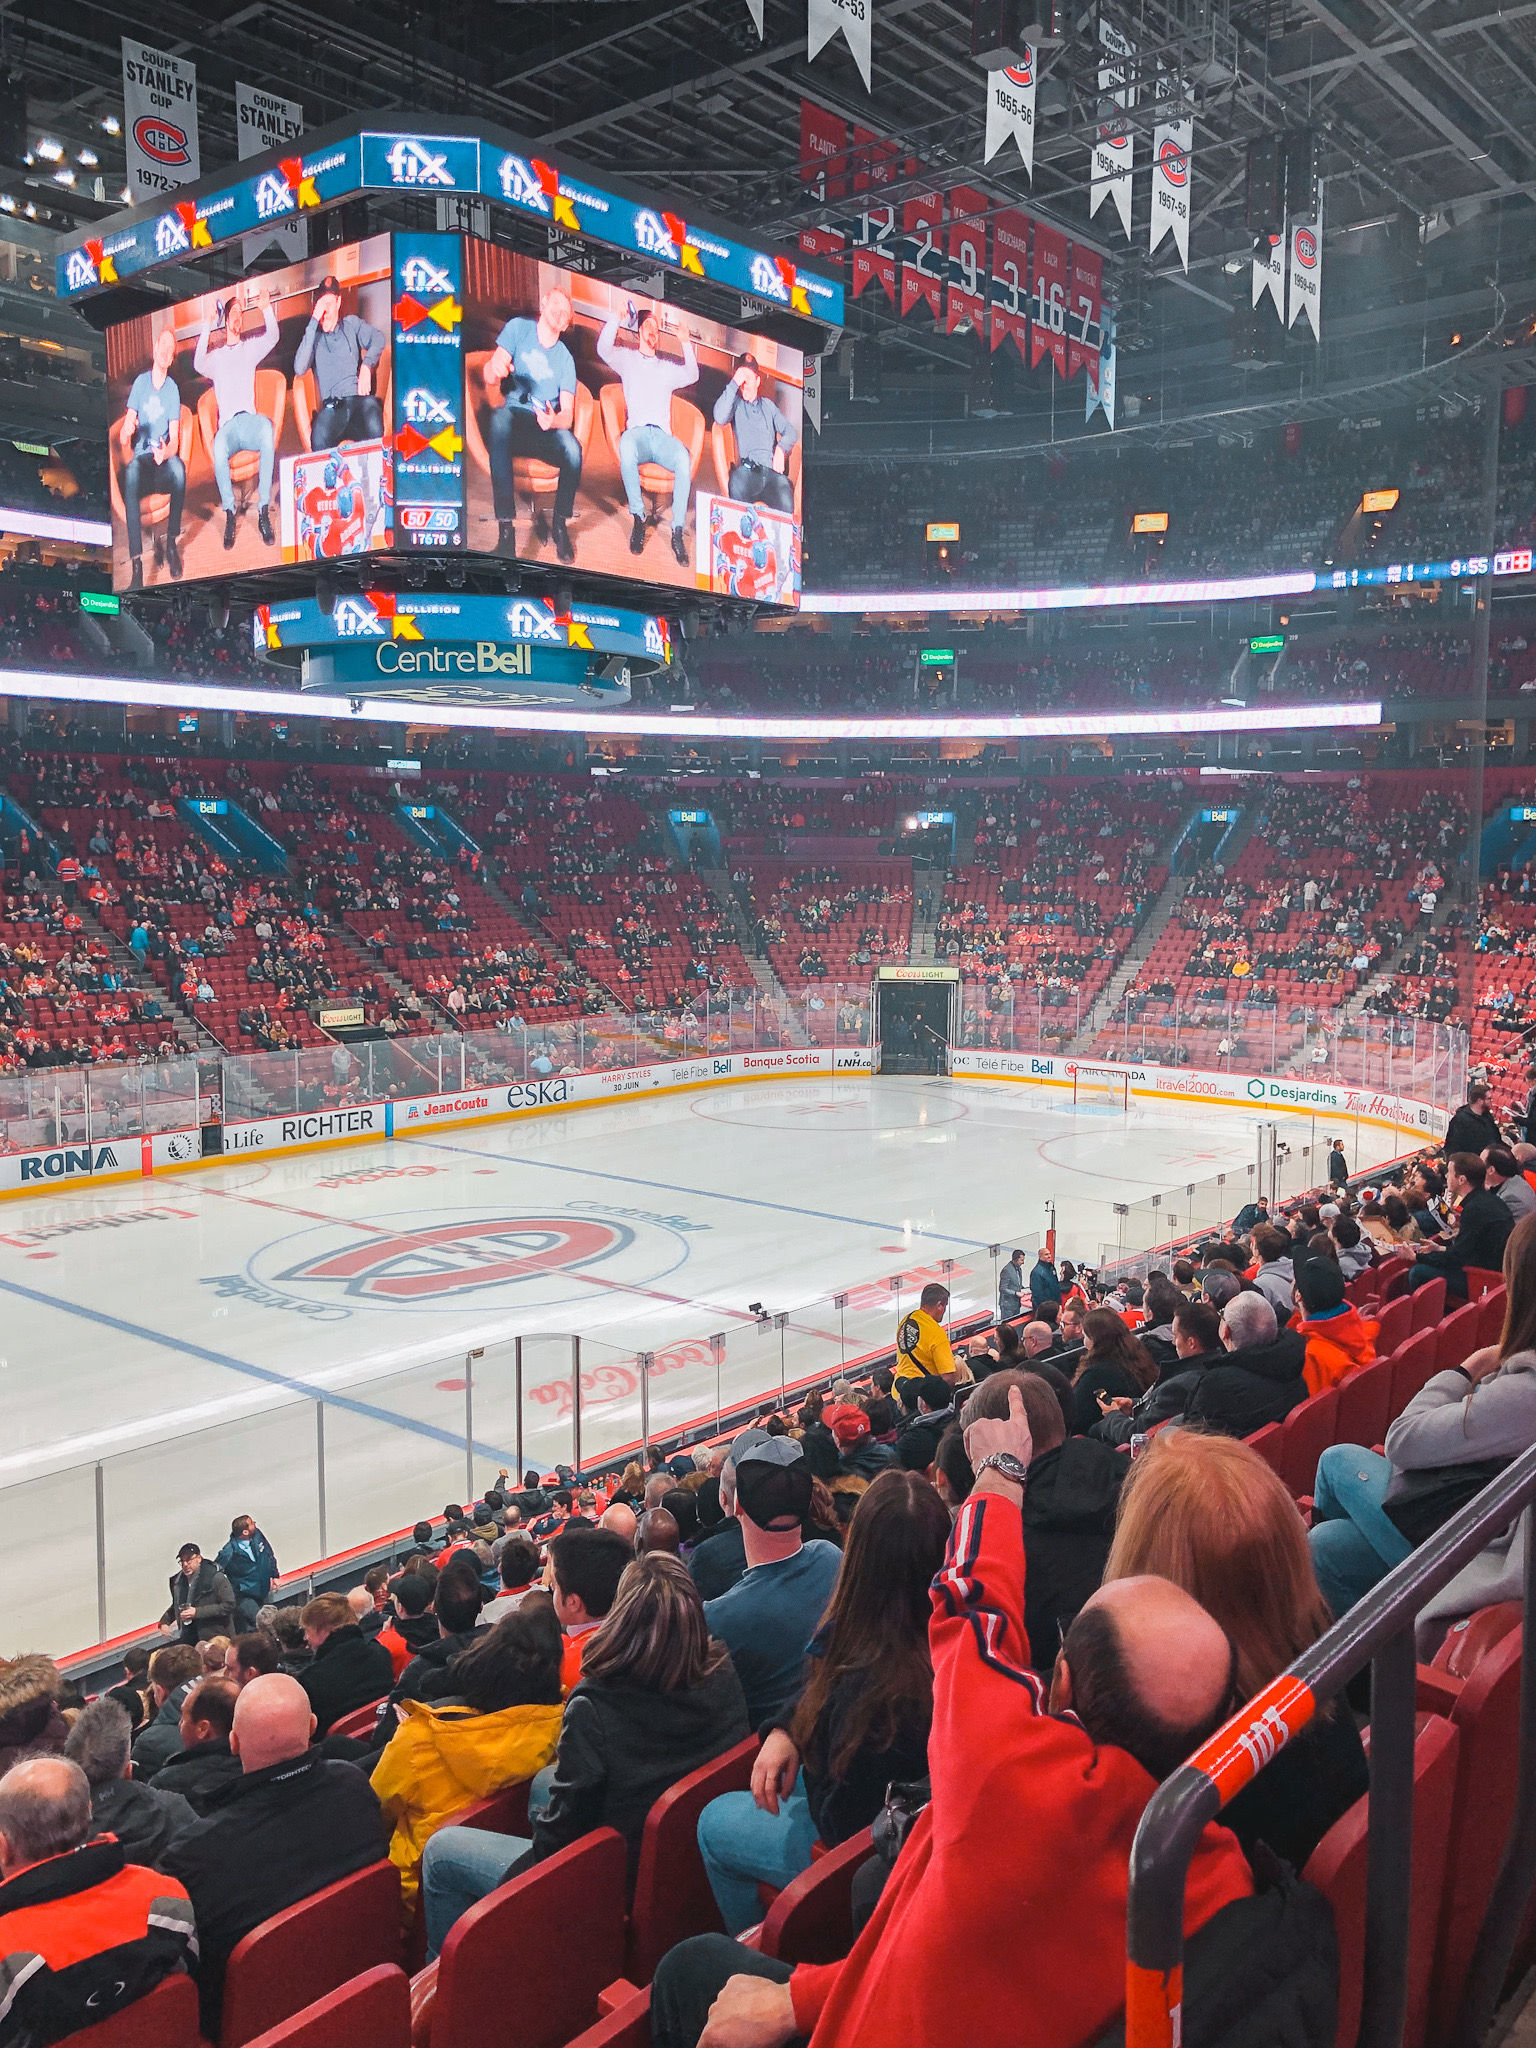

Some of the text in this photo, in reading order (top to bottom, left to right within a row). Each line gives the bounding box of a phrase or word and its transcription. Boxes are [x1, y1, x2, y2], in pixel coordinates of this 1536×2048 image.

[142, 50, 179, 74] COUPE
[126, 60, 193, 103] STANLEY
[150, 92, 173, 110] CUP
[253, 94, 287, 116] COUPE
[995, 88, 1032, 126] 1955-56
[240, 103, 301, 140] STANLEY
[809, 133, 837, 156] PLANTE
[302, 153, 346, 178] COLLISION
[136, 168, 186, 192] 1972-7
[392, 175, 440, 186] AUTO
[503, 190, 538, 206] AUTO
[558, 185, 610, 213] COLLISION
[1158, 190, 1187, 219] 1957-58
[196, 197, 235, 220] COLLISION
[258, 204, 286, 219] AUTO
[103, 237, 137, 257] COLLISION
[638, 240, 668, 257] AUTO
[686, 235, 730, 259] COLLISION
[803, 235, 817, 250] 1952
[916, 218, 934, 279] 2
[997, 228, 1027, 254] BOUCHARD
[158, 243, 181, 258] AUTO
[858, 259, 870, 273] 1951
[1043, 250, 1059, 269] LACH
[960, 240, 977, 297] 9
[70, 278, 91, 291] AUTO
[405, 285, 443, 293] AUTO
[754, 284, 781, 298] AUTO
[795, 276, 834, 299] COLLISION
[1003, 260, 1019, 316] 3
[1293, 272, 1317, 296] 1959-60
[1036, 276, 1064, 336] 16
[1078, 295, 1093, 346] 7
[396, 334, 461, 346] COLLISION
[406, 415, 443, 423] AUTO
[397, 464, 461, 475] COLLISION
[411, 532, 448, 546] 17670
[1450, 556, 1489, 577] 9:55
[90, 599, 119, 609] Desjardins
[397, 605, 461, 614] COLLISION
[269, 610, 302, 624] COLLISION
[572, 614, 621, 628] COLLISION
[337, 629, 373, 637] AUTO
[511, 632, 550, 640] AUTO
[200, 801, 217, 814] Bell
[412, 806, 427, 819] Bell
[1211, 810, 1228, 822] Bell
[1523, 807, 1536, 820] Be
[681, 811, 697, 822] Bell
[927, 812, 943, 823] Bell
[895, 968, 944, 979] Coors LIGHT
[322, 1013, 361, 1024] Coors LIGHT
[713, 1058, 732, 1075] Bell
[743, 1053, 820, 1069] Banque Scotia
[837, 1058, 875, 1068] LNH.co
[975, 1056, 1024, 1072] Télé Fibe
[1031, 1058, 1054, 1076] Bell
[601, 1069, 651, 1084] HARRY STYLES
[671, 1068, 689, 1081] Télé
[507, 1078, 568, 1109] eska
[613, 1081, 640, 1092] 30 JUIN
[1156, 1078, 1235, 1097] itravel2000.com
[1270, 1083, 1337, 1106] Desjardins
[424, 1103, 453, 1117] Jean
[454, 1096, 488, 1112] Coutu
[1343, 1091, 1367, 1113] Tim
[1368, 1095, 1415, 1125] Hortons
[282, 1109, 374, 1142] RICHTER
[234, 1128, 264, 1149] Life
[21, 1146, 119, 1181] RONA
